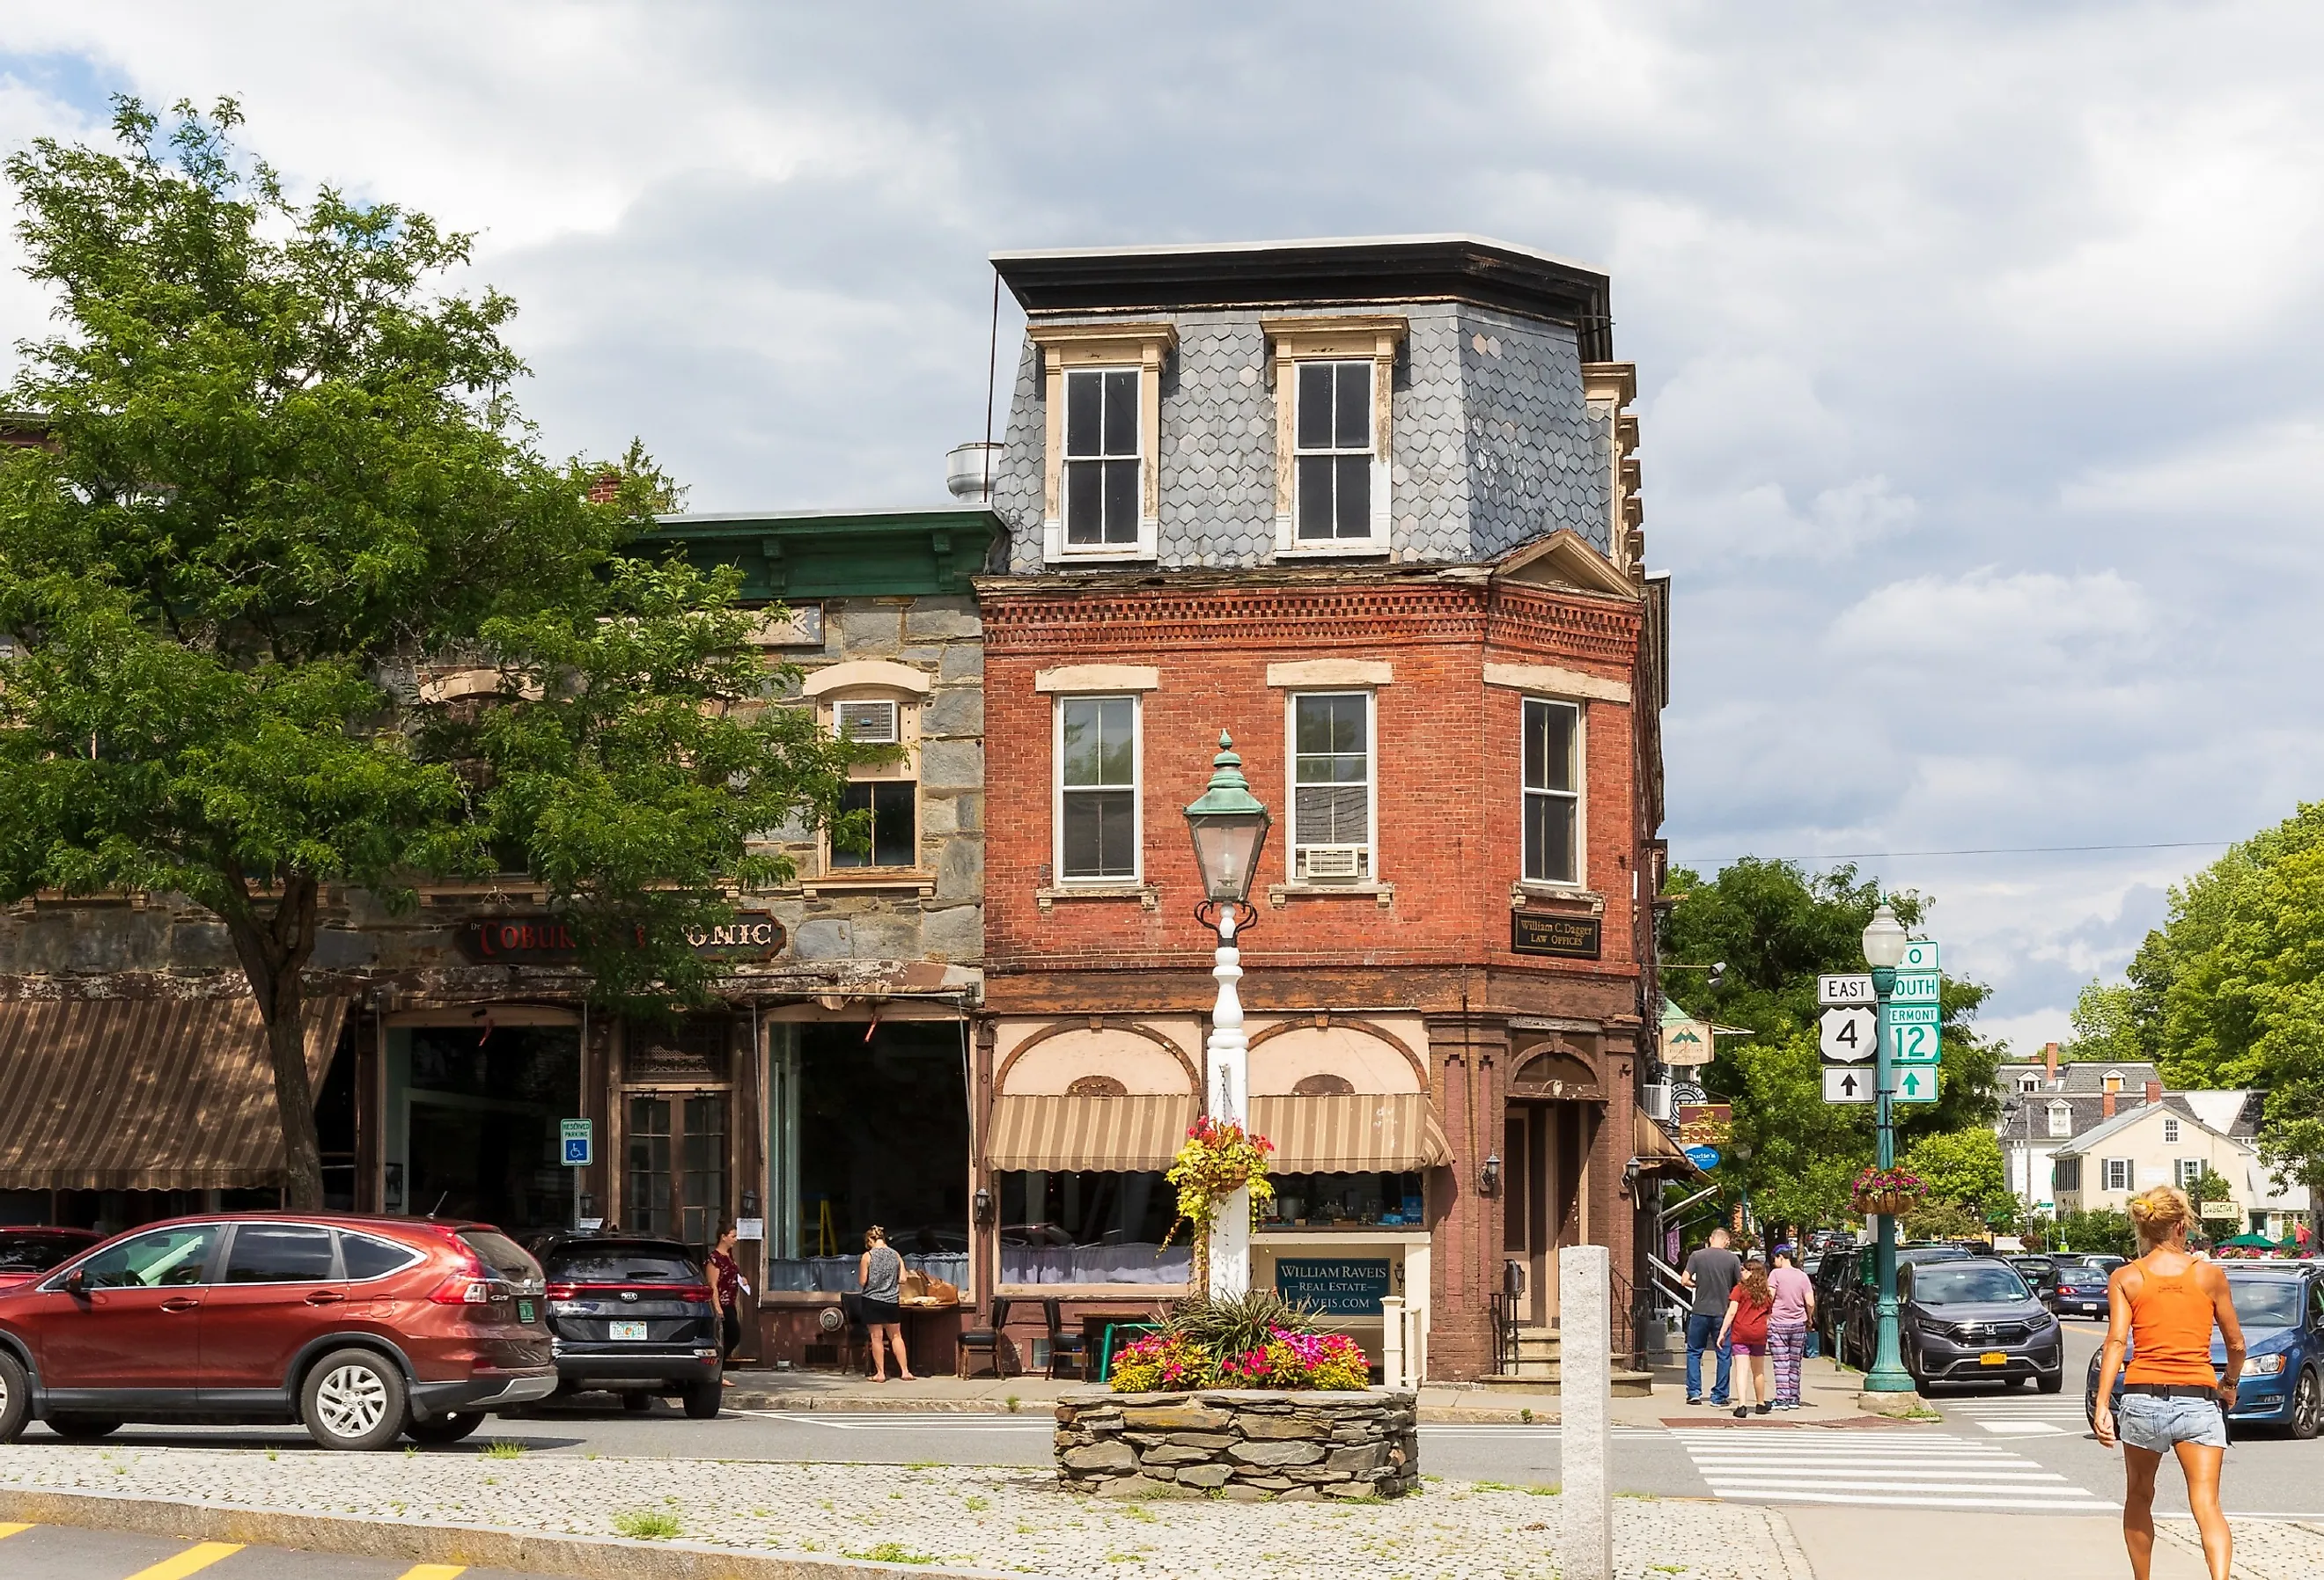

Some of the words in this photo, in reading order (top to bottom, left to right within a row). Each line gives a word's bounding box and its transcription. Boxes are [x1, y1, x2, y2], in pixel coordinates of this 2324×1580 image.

[681, 922, 772, 947] ONIC
[1521, 920, 1553, 932] William
[1555, 922, 1563, 933] C.
[1564, 923, 1592, 937] Dagger
[1531, 934, 1548, 943] LAW
[1551, 935, 1583, 946] OFFICES
[1900, 948, 1923, 965] O
[1828, 981, 1866, 997] EAST
[1895, 979, 1935, 996] OUTH
[1890, 1010, 1935, 1021] ERMONT
[1835, 1018, 1858, 1049] 4
[1895, 1026, 1925, 1057] 12
[1281, 1265, 1339, 1278] WILLIAM
[1342, 1265, 1386, 1278] RAVEIS
[1298, 1282, 1326, 1291] REAL
[1328, 1282, 1368, 1291] ESTATE
